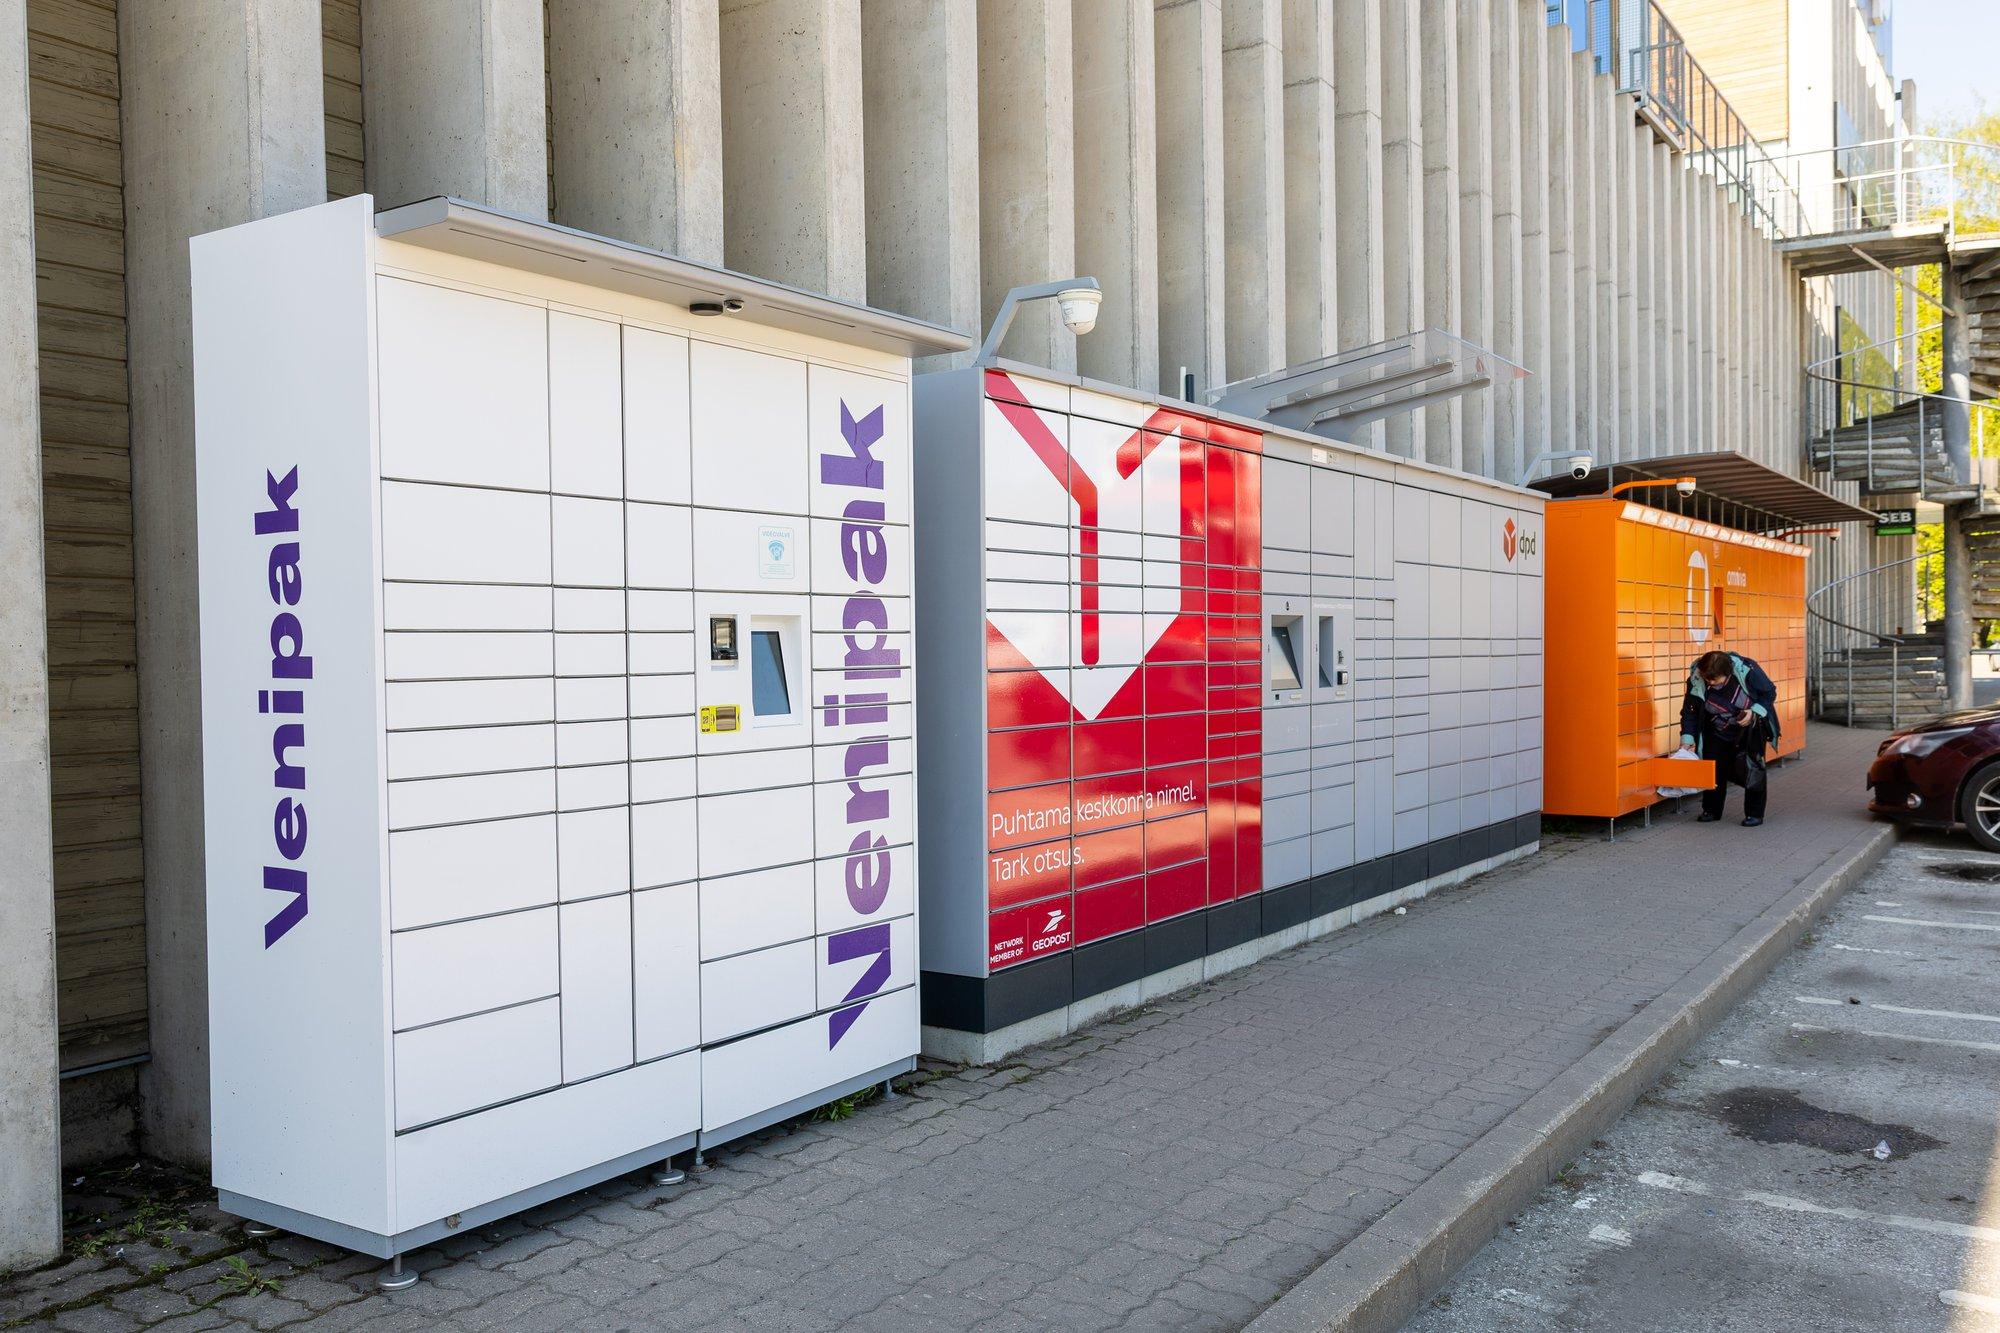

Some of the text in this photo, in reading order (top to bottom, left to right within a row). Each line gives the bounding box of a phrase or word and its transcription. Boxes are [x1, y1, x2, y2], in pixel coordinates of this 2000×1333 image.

[1878, 511, 1912, 523] SEB
[1519, 529, 1536, 560] dpd
[254, 463, 313, 950] Venipak
[820, 397, 901, 1051] Venipak
[992, 780, 1197, 838] Puhtama keskkonna nimel.
[992, 846, 1085, 882] Tark otsus.
[990, 948, 1024, 963] MEMBER OF
[994, 936, 1024, 951] NETWORK
[1032, 932, 1071, 951] GEOPOST
